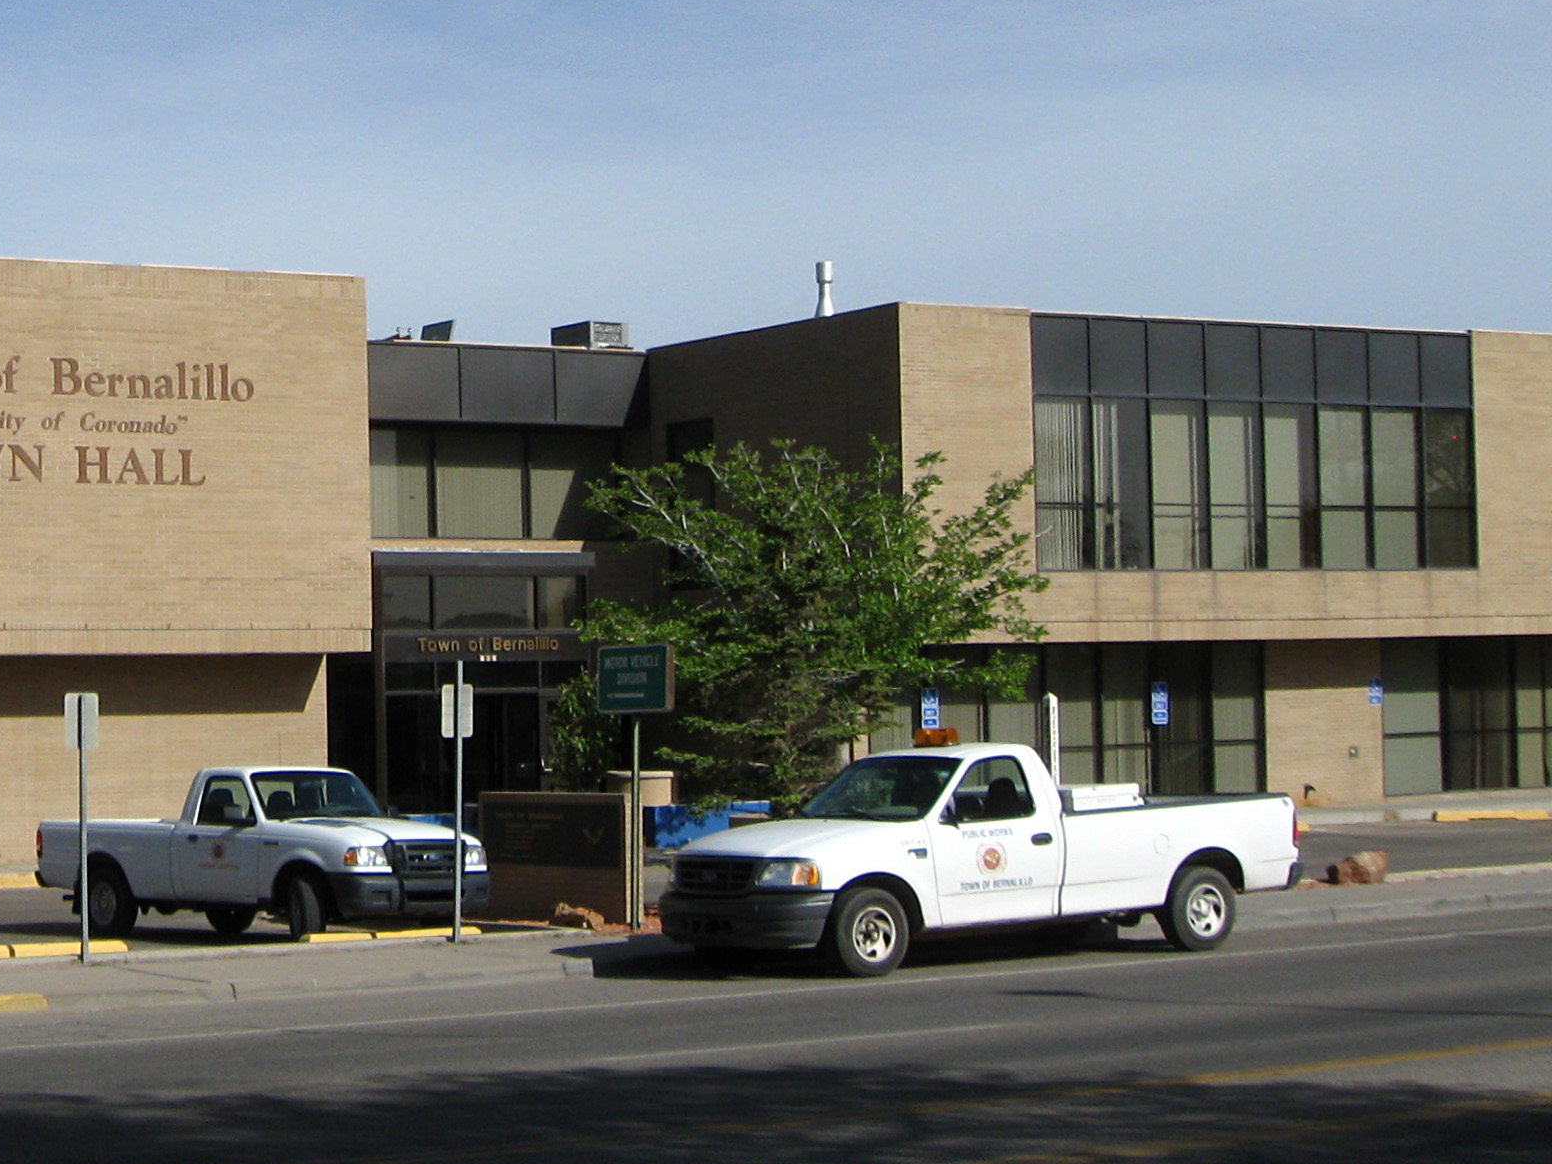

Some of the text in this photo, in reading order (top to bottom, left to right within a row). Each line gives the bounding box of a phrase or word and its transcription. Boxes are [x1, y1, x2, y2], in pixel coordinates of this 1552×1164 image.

[50, 356, 255, 402] Bernalillo
[41, 411, 64, 432] of
[74, 445, 206, 486] HALL
[418, 637, 559, 651] Town of Bernalillo
[962, 827, 1013, 838] PUBLIC WORKS
[960, 881, 980, 892] TOWN
[982, 879, 991, 890] OF
